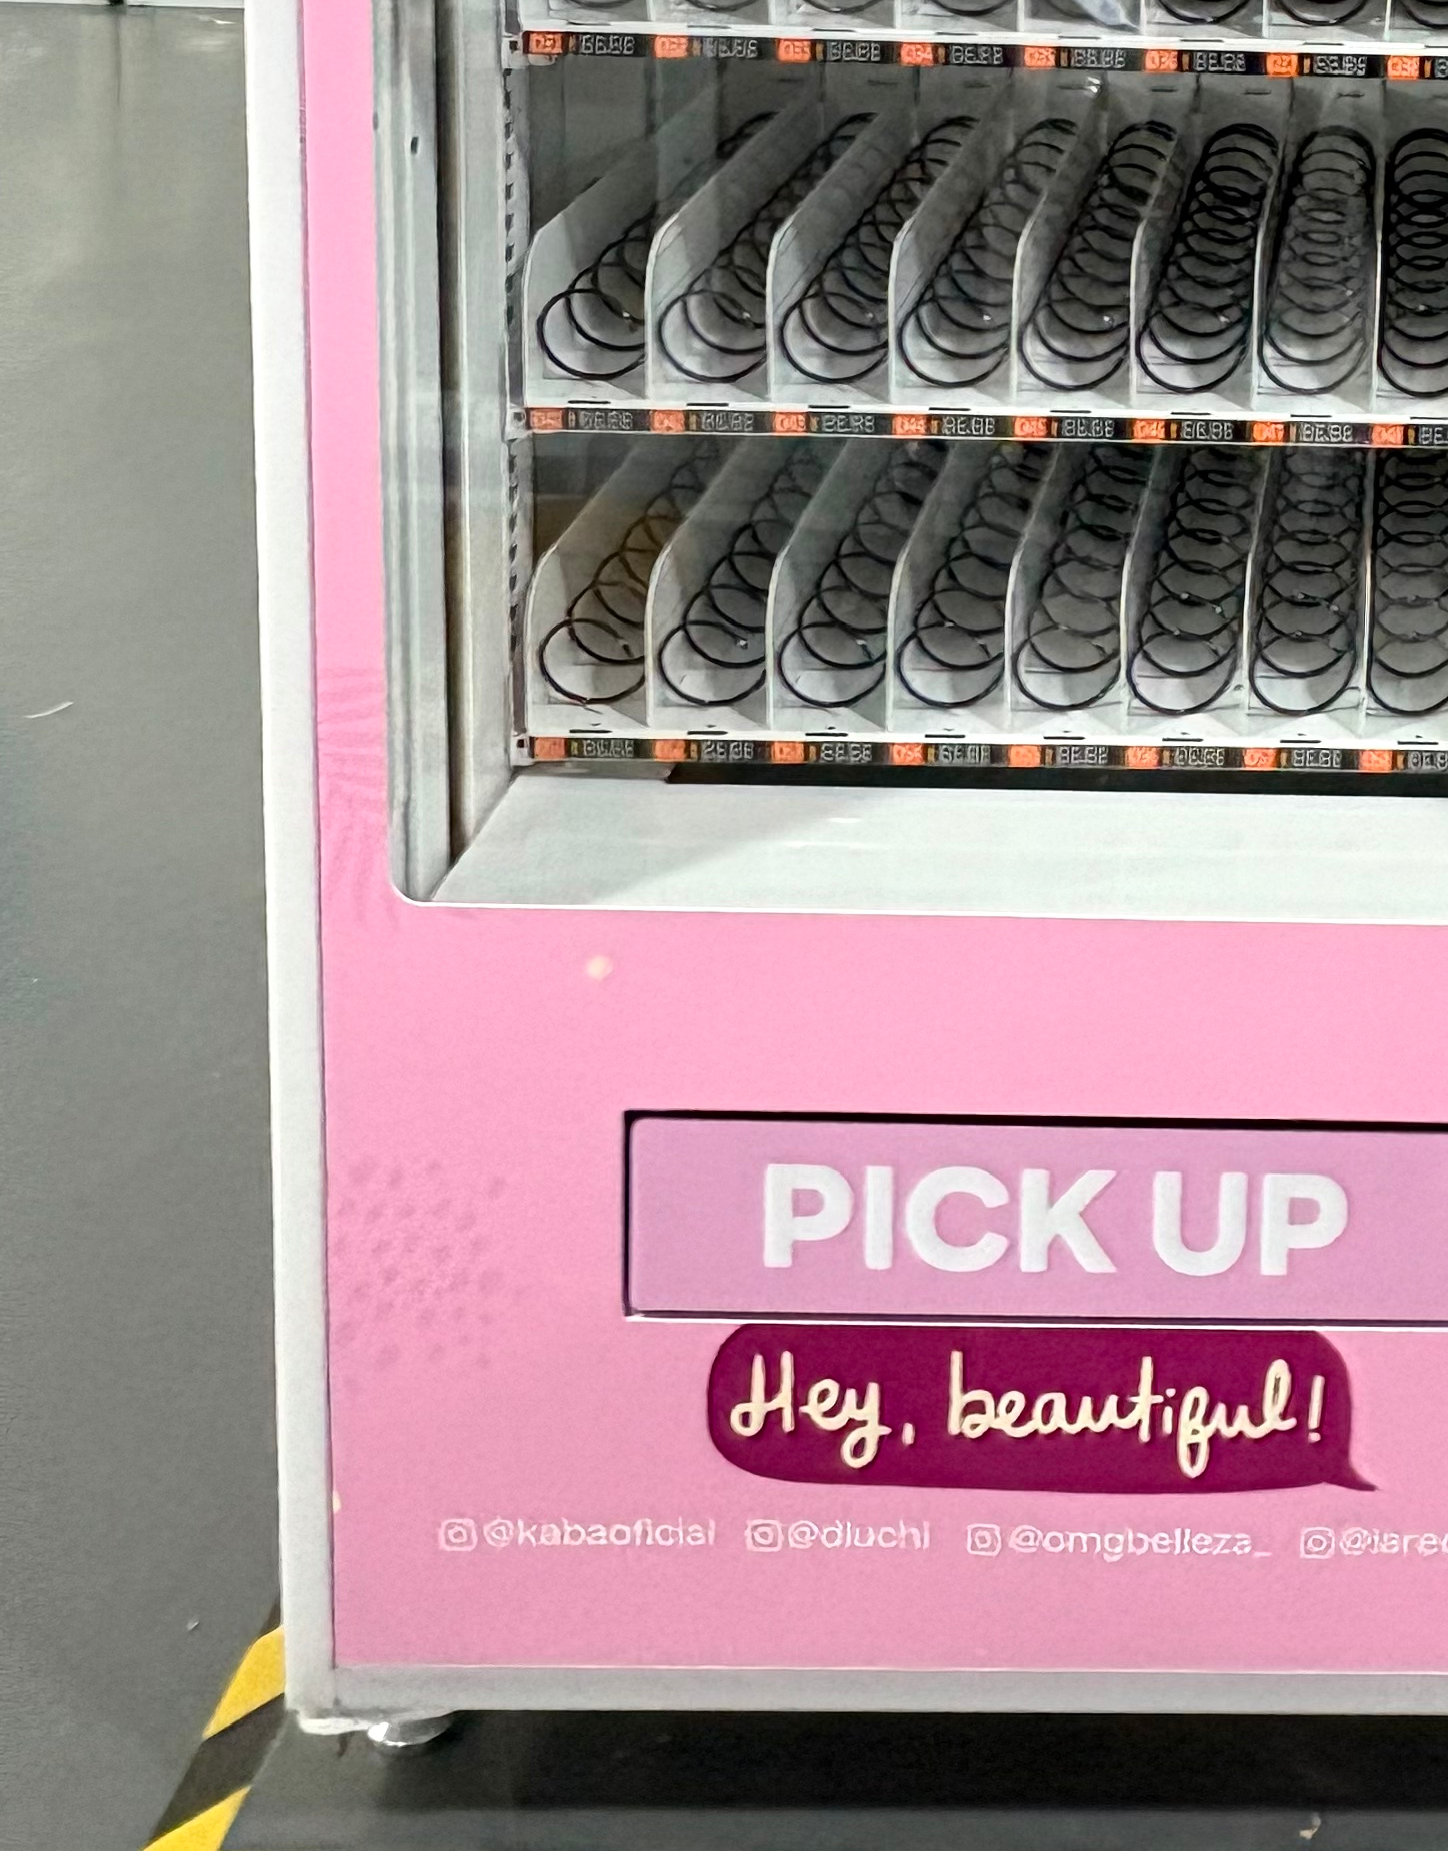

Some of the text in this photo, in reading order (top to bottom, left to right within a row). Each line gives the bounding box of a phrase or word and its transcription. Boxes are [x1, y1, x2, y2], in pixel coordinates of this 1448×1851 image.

[763, 1162, 1349, 1277] PICK UP
[728, 1350, 1326, 1479] Hey, beautiful!
